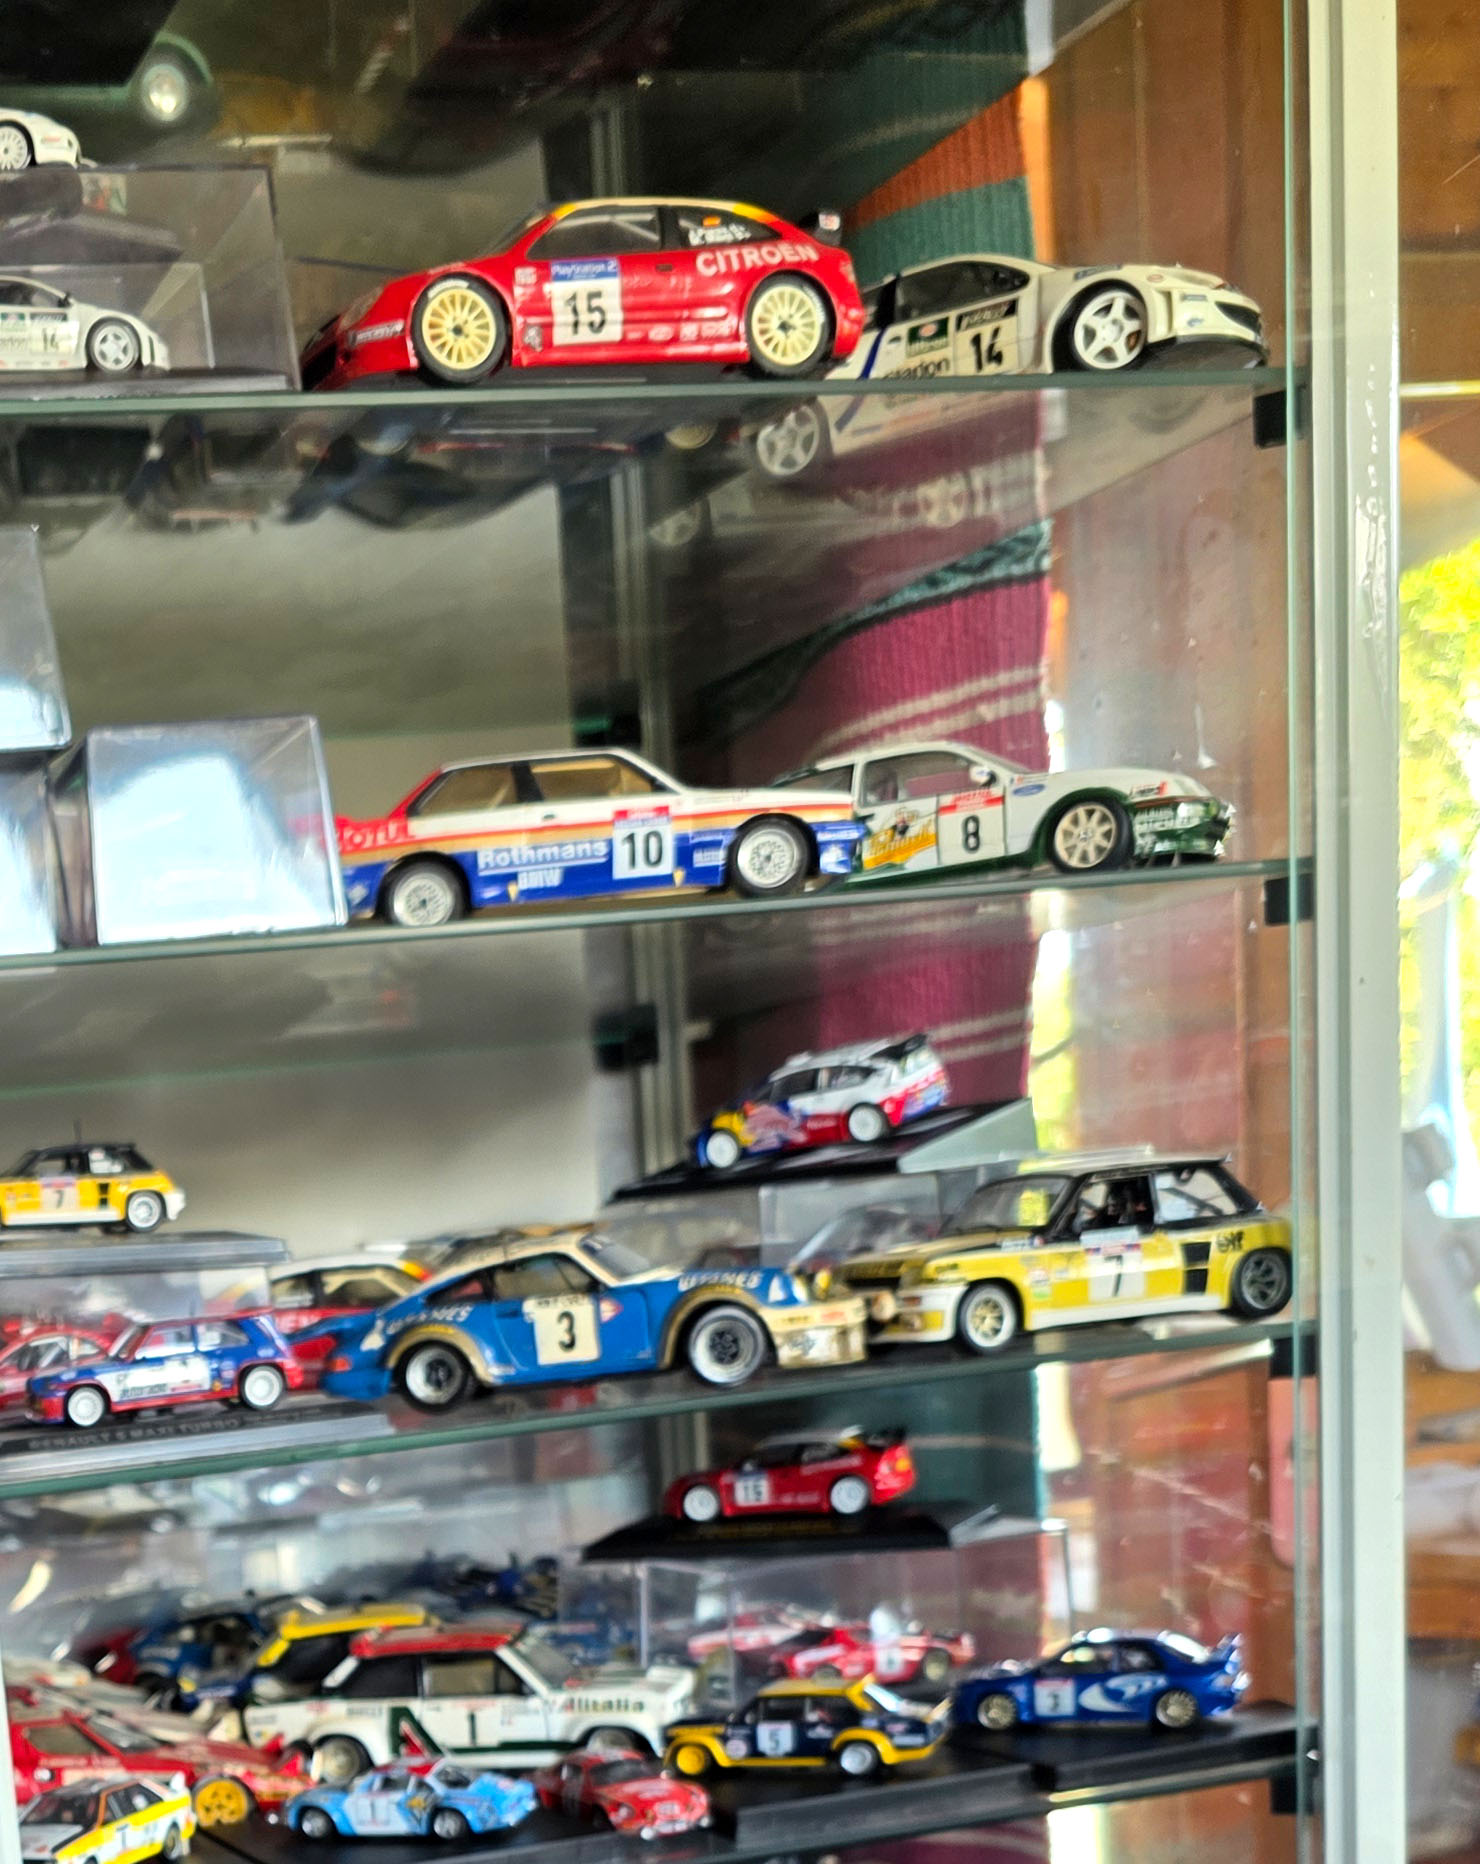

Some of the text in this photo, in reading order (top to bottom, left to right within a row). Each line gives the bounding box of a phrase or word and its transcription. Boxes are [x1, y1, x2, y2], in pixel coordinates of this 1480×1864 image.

[563, 289, 607, 336] 15
[969, 326, 1004, 373] 14
[621, 829, 663, 870] 10
[962, 814, 981, 852] 8
[477, 840, 608, 870] Rothmans
[558, 1310, 577, 1353] 3
